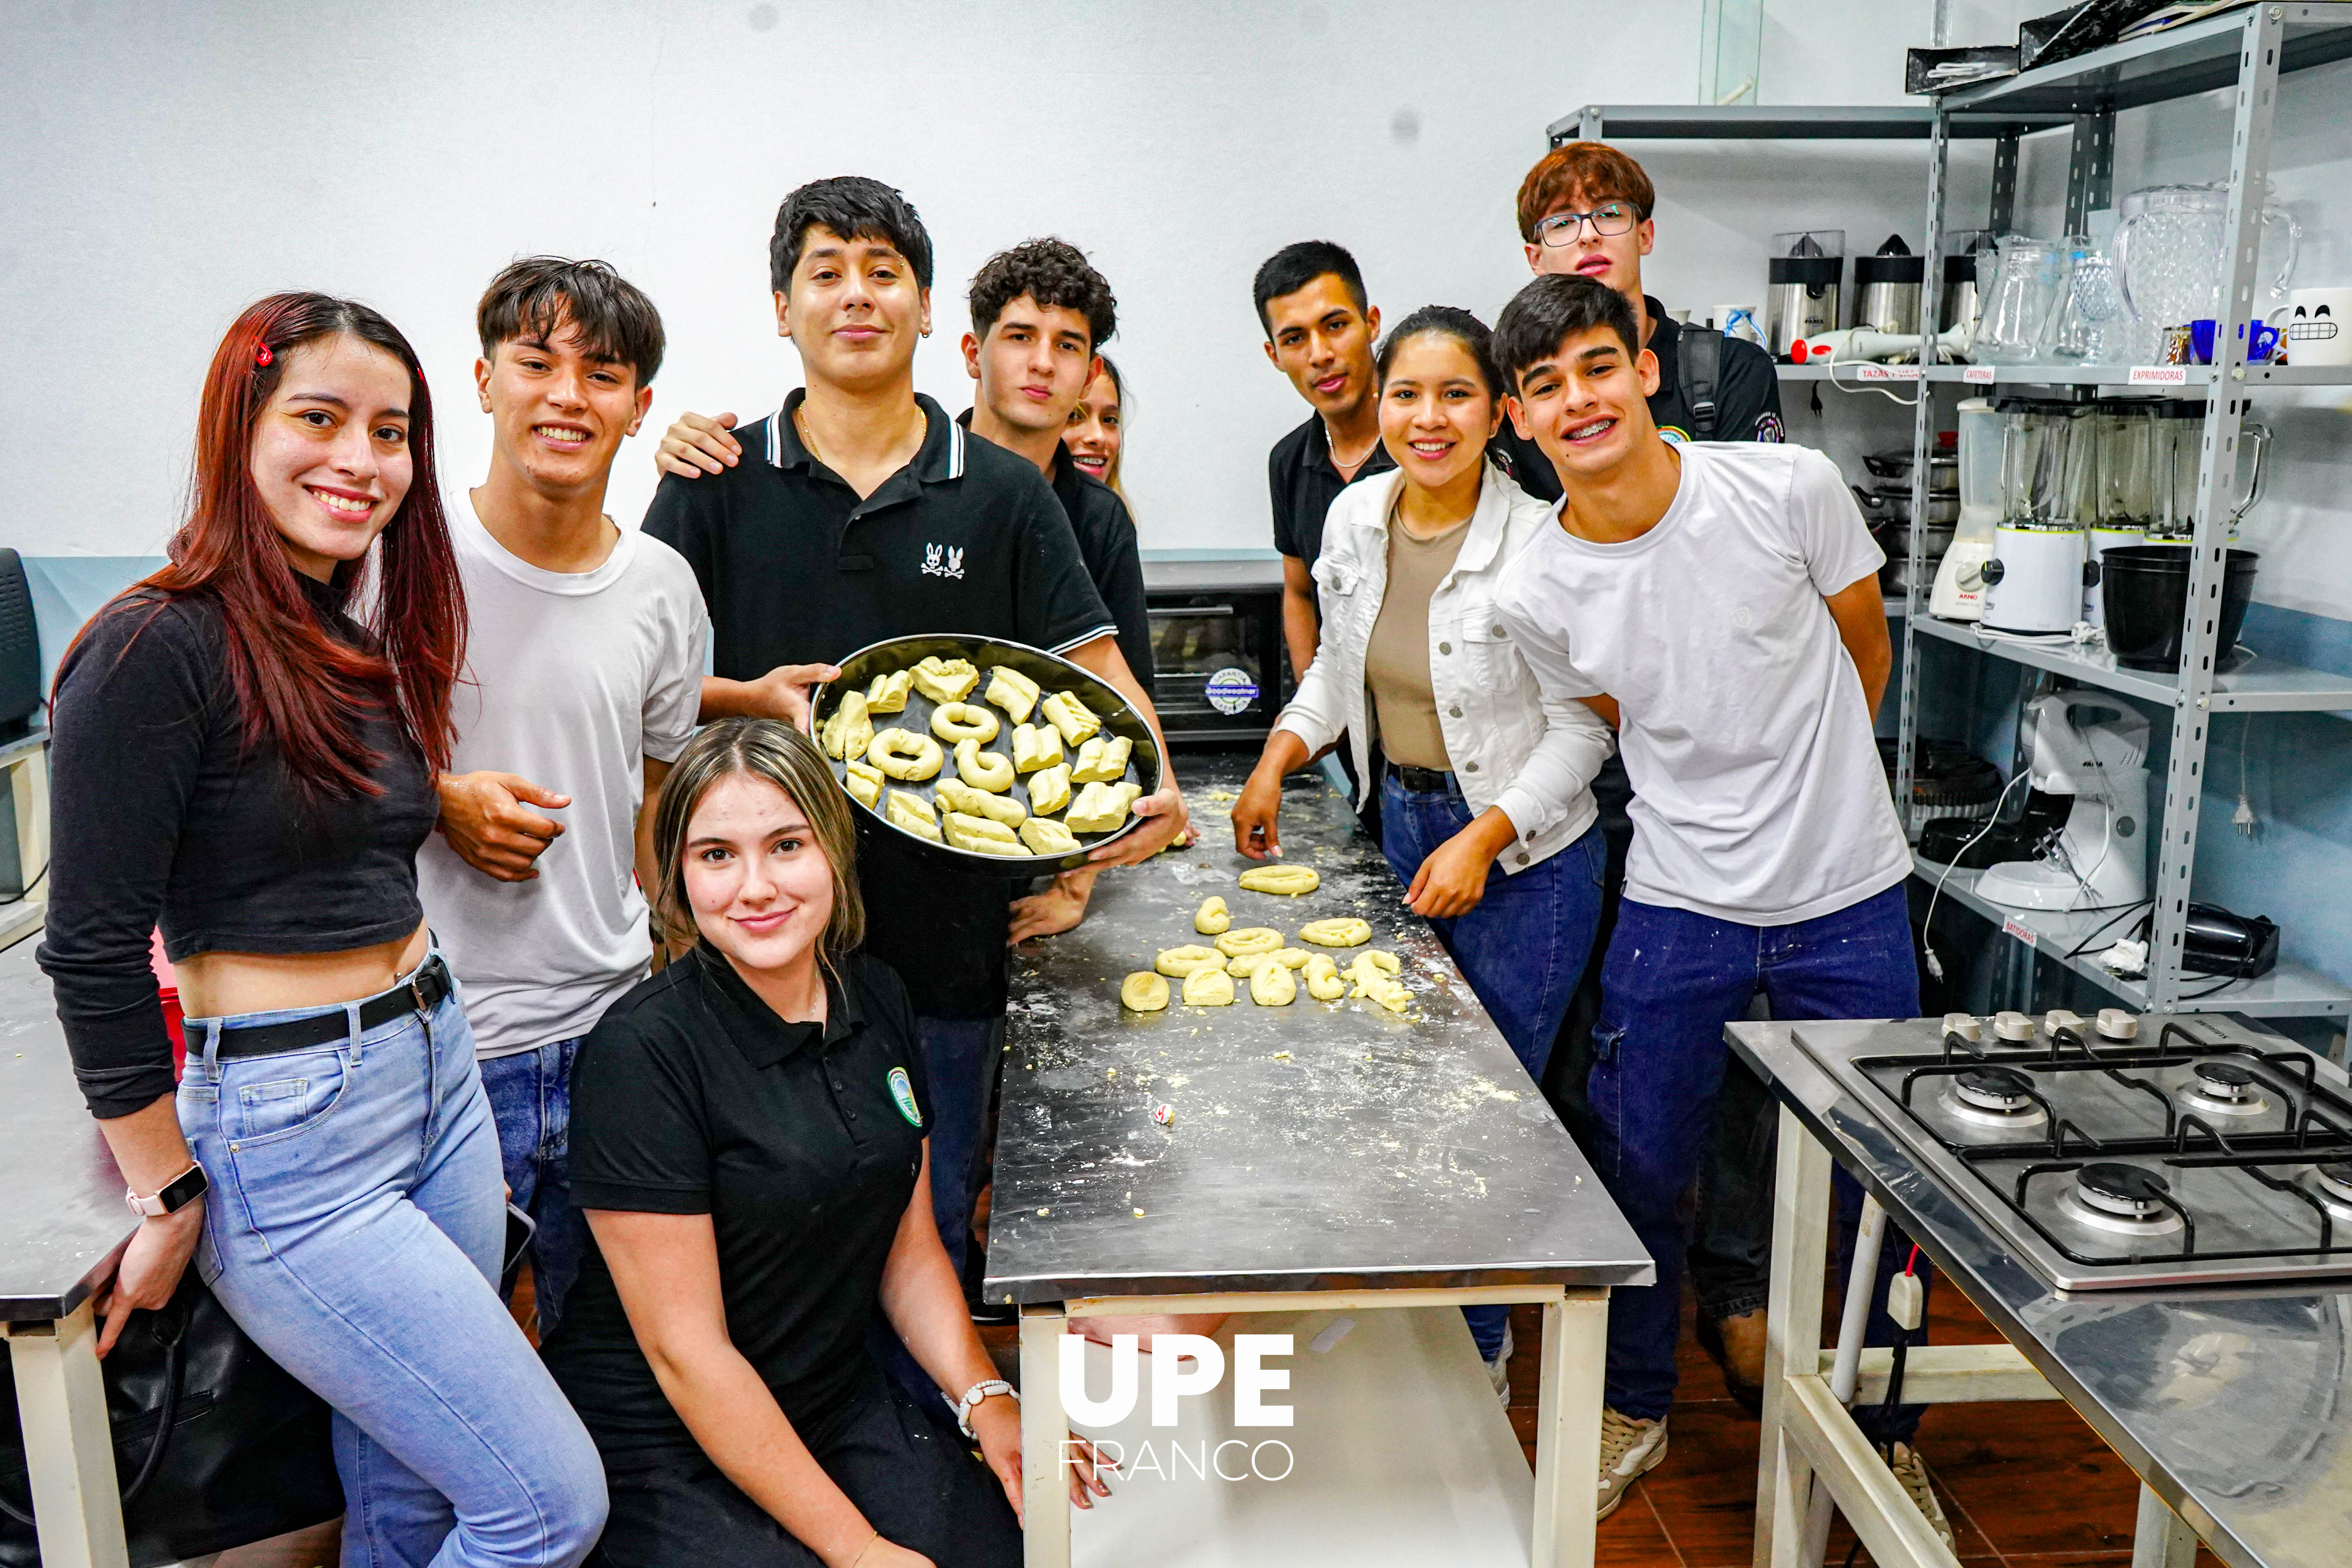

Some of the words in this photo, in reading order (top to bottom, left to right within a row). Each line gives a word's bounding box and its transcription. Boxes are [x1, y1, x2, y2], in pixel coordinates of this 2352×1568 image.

[1966, 370, 1992, 379] CAFETERAS
[2133, 370, 2183, 380] EXPRIMIDORAS
[2007, 921, 2034, 943] BATIDORAS
